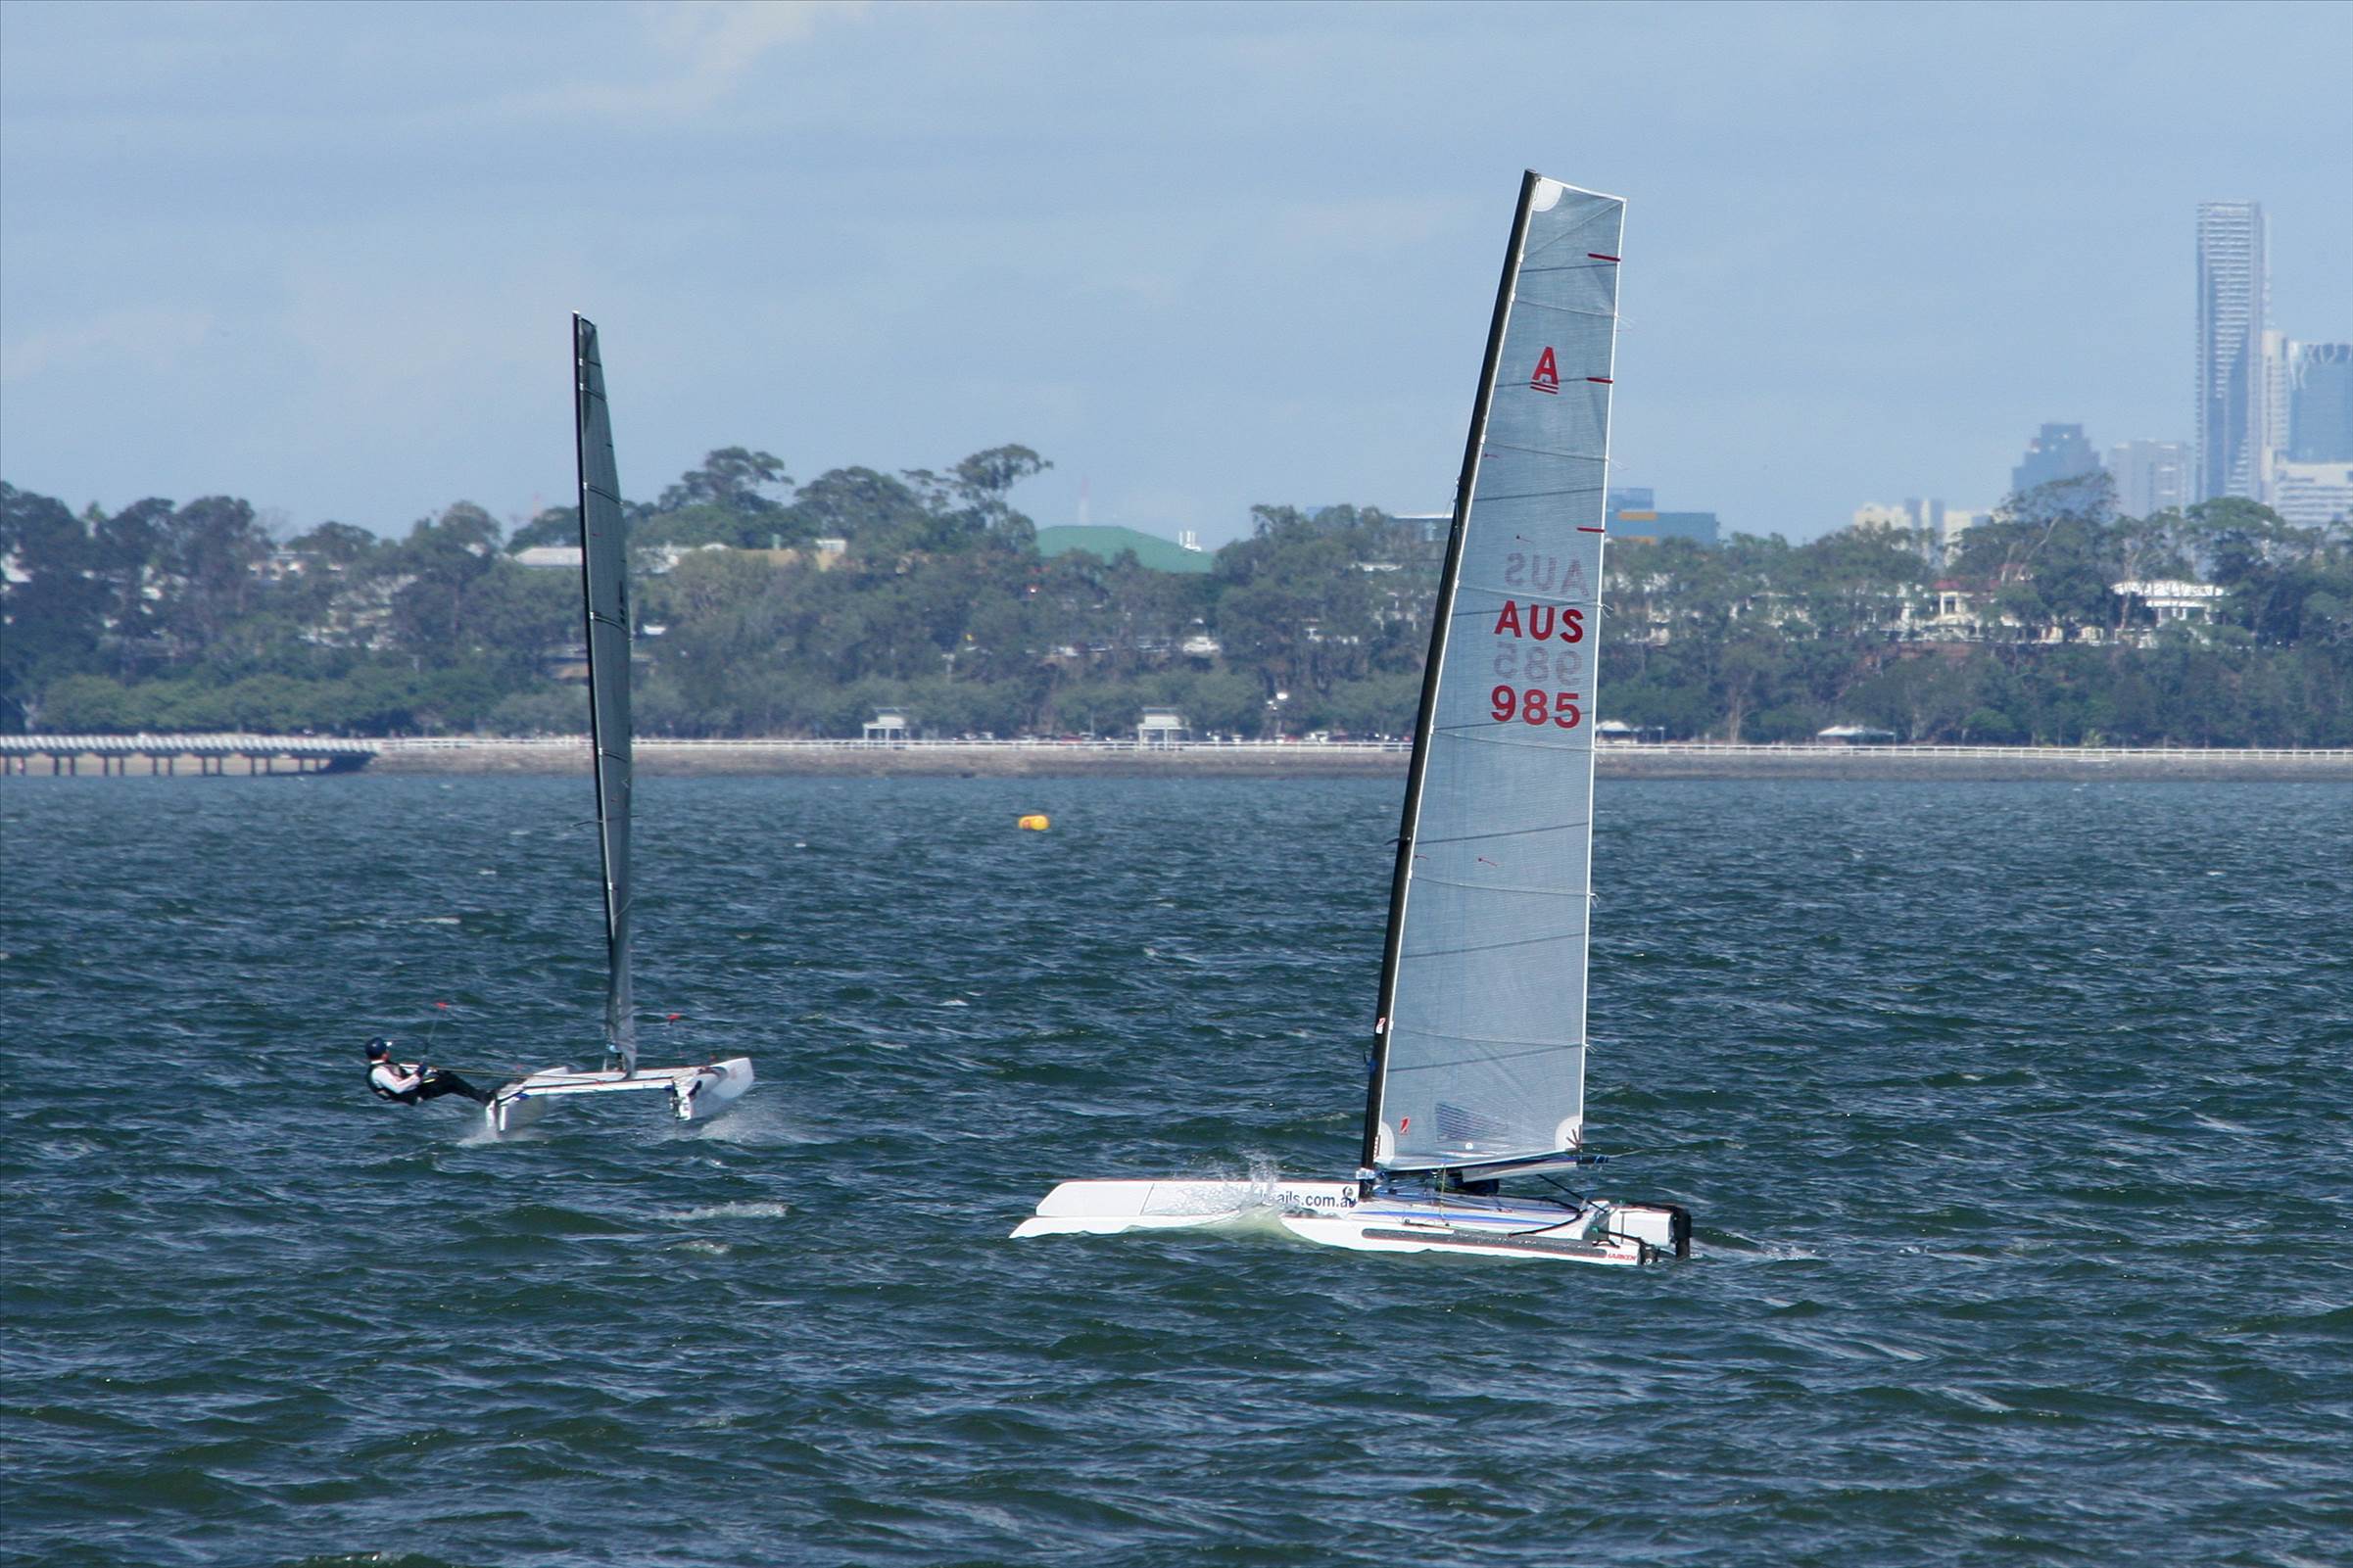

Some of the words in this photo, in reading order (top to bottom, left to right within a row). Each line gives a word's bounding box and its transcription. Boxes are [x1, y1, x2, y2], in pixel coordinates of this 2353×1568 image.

[1532, 346, 1560, 385] A
[1494, 599, 1584, 643] AUS
[1491, 685, 1580, 729] 985
[1271, 1190, 1357, 1209] ails.com.au
